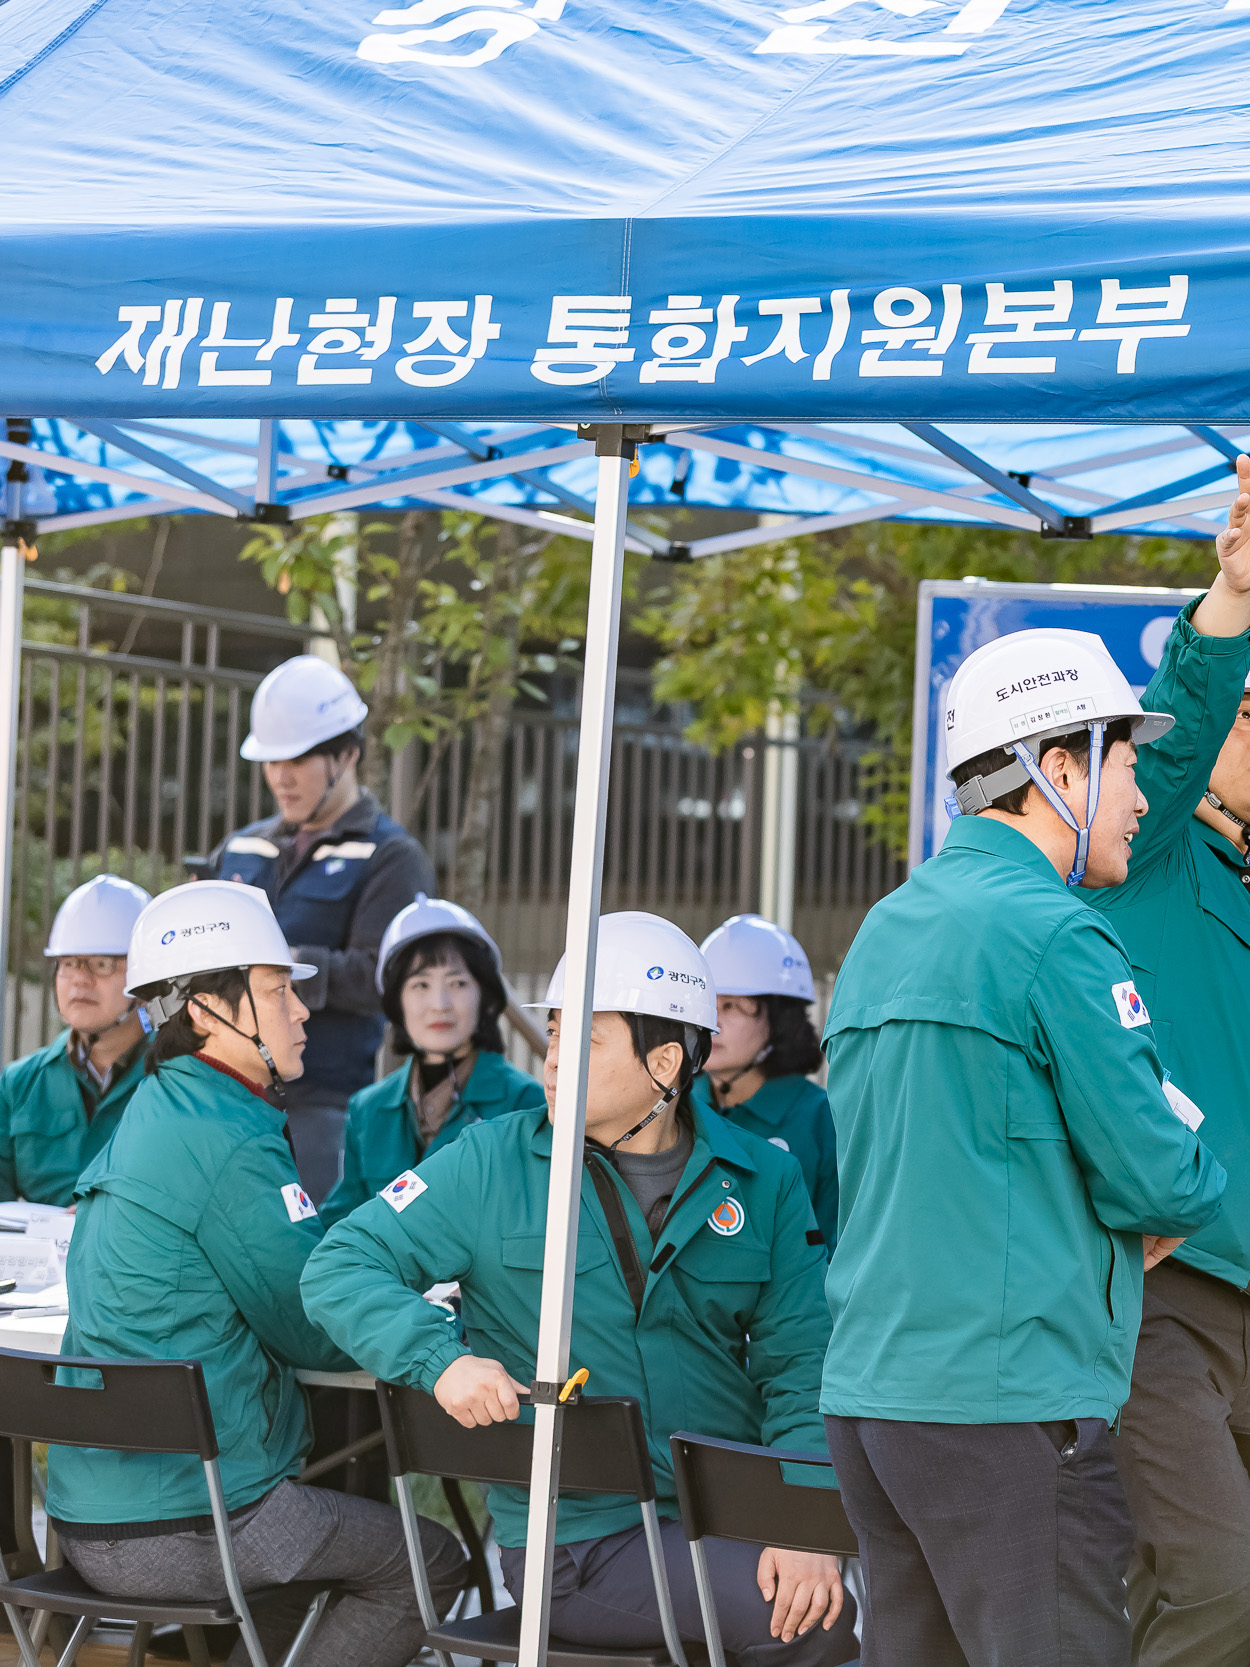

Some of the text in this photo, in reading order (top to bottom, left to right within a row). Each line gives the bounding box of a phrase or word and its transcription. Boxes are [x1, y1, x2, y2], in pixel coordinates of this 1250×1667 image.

[94, 275, 1191, 390] 재난현장 통합지원본부
[995, 668, 1080, 703] 도시안전과장
[179, 921, 231, 937] 광진구청
[667, 970, 706, 989] 광진구청
